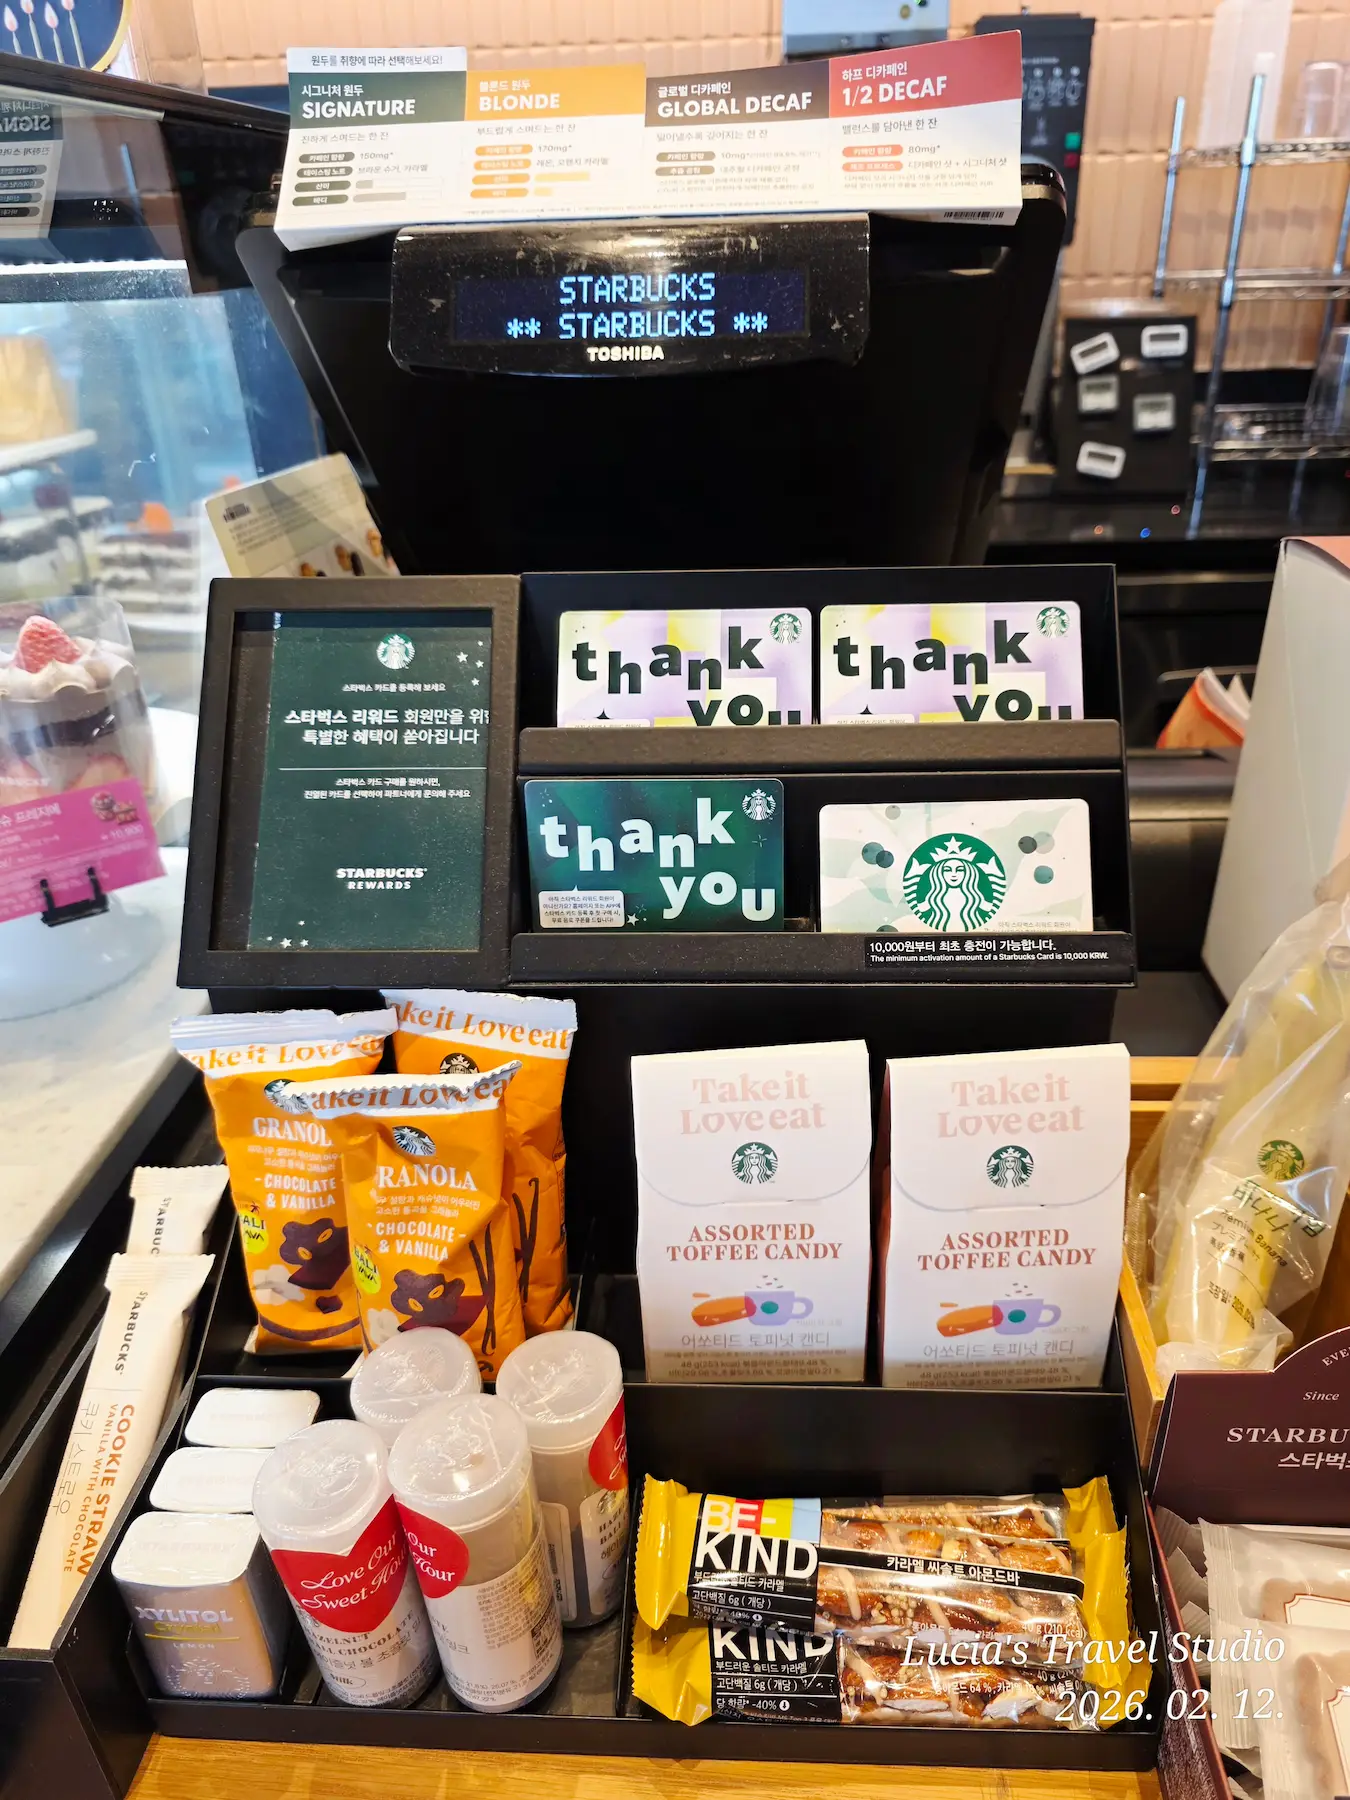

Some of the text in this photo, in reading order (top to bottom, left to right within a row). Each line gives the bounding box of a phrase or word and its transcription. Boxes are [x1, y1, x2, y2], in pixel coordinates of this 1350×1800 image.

[311, 54, 443, 67] 원두를 취향에 따라 선택해보세요!
[841, 61, 909, 81] 하프 디카페인
[301, 84, 364, 97] 시그니처 원두
[657, 82, 732, 98] 글로벌 디카페인
[842, 75, 948, 107] 1/2 DECAF
[302, 99, 416, 119] SIGNATURE
[479, 93, 561, 112] BLONDE
[657, 92, 813, 118] GLOBAL DECAF
[883, 120, 913, 132] 담아낸
[915, 119, 925, 131] 한
[559, 272, 715, 304] STARBUCKS
[558, 309, 716, 339] STARBUCKS
[587, 346, 664, 361] TOSHIBA
[572, 626, 765, 694] thank
[833, 620, 1032, 690] thank
[342, 683, 373, 692] 스타벅스
[423, 683, 447, 692] 보세요
[284, 709, 348, 725] 스타벅스
[352, 709, 400, 725] 리워드
[404, 708, 464, 725] 회원만을
[302, 729, 480, 745] 특별한 혜택이 쏟아집니다
[335, 778, 366, 787] 스타벅스
[367, 778, 383, 787] 카드
[448, 789, 472, 798] 주세요
[540, 797, 735, 872] thank
[336, 867, 425, 879] STARBUCKS
[347, 881, 412, 890] REWARDS
[659, 871, 776, 921] you
[869, 939, 1058, 953] 10,000원부터 최초 충전이 가능합니다.
[871, 954, 885, 963] The
[885, 954, 919, 963] minimum
[919, 953, 955, 962] activation
[956, 954, 983, 962] amount
[984, 953, 992, 962] of
[999, 953, 1036, 961] Starbucks
[1037, 952, 1054, 961] Card
[1055, 952, 1062, 960] is
[1063, 952, 1089, 961] 10,000
[1089, 952, 1110, 960] KRW.
[462, 1013, 570, 1051] Love eat
[692, 1069, 812, 1104] Take it
[951, 1072, 1071, 1106] Take it
[681, 1102, 827, 1135] Love eat
[938, 1104, 1085, 1138] Love eat
[264, 1173, 337, 1194] CHOCOLATE
[376, 1163, 478, 1192] RANOLA
[266, 1193, 336, 1211] & VANILLA
[376, 1220, 456, 1243] CHOCOLATE
[688, 1223, 815, 1242] ASSORTED
[941, 1228, 1069, 1250] ASSORTED
[378, 1239, 449, 1263] & VANILLA
[667, 1242, 843, 1262] TOFFEE CANDY
[917, 1248, 1096, 1271] TOFFEE CANDY
[1255, 1234, 1288, 1268] Banana
[115, 1291, 148, 1373] STARBUCKS
[681, 1331, 831, 1348] 어쏘티드 토피넛 캔디
[923, 1339, 1075, 1359] 어쏘티드 토피넛 캔디
[1303, 1391, 1340, 1402] Since
[1227, 1427, 1350, 1444] STARBU
[52, 1401, 100, 1516] 쿠키 스트로우
[63, 1403, 119, 1573] VANILLA WITH CHOCOLATE
[76, 1404, 135, 1577] COOKIE STRAW
[704, 1500, 777, 1536] BE-
[408, 1531, 437, 1557] Our
[301, 1531, 397, 1589] Love Our
[694, 1531, 819, 1579] KIND
[887, 1556, 1021, 1587] 카라멜 씨솔트 아몬드바
[301, 1587, 369, 1609] Sweet
[692, 1590, 740, 1606] 고단백질 6g
[134, 1606, 233, 1623] XYLITOL
[713, 1623, 833, 1661] KIND
[716, 1661, 807, 1674] 부드러운 솔티드 카라멜
[716, 1678, 766, 1692] 고단백질 6g
[969, 1684, 981, 1694] 64
[752, 1700, 777, 1710] -40%
